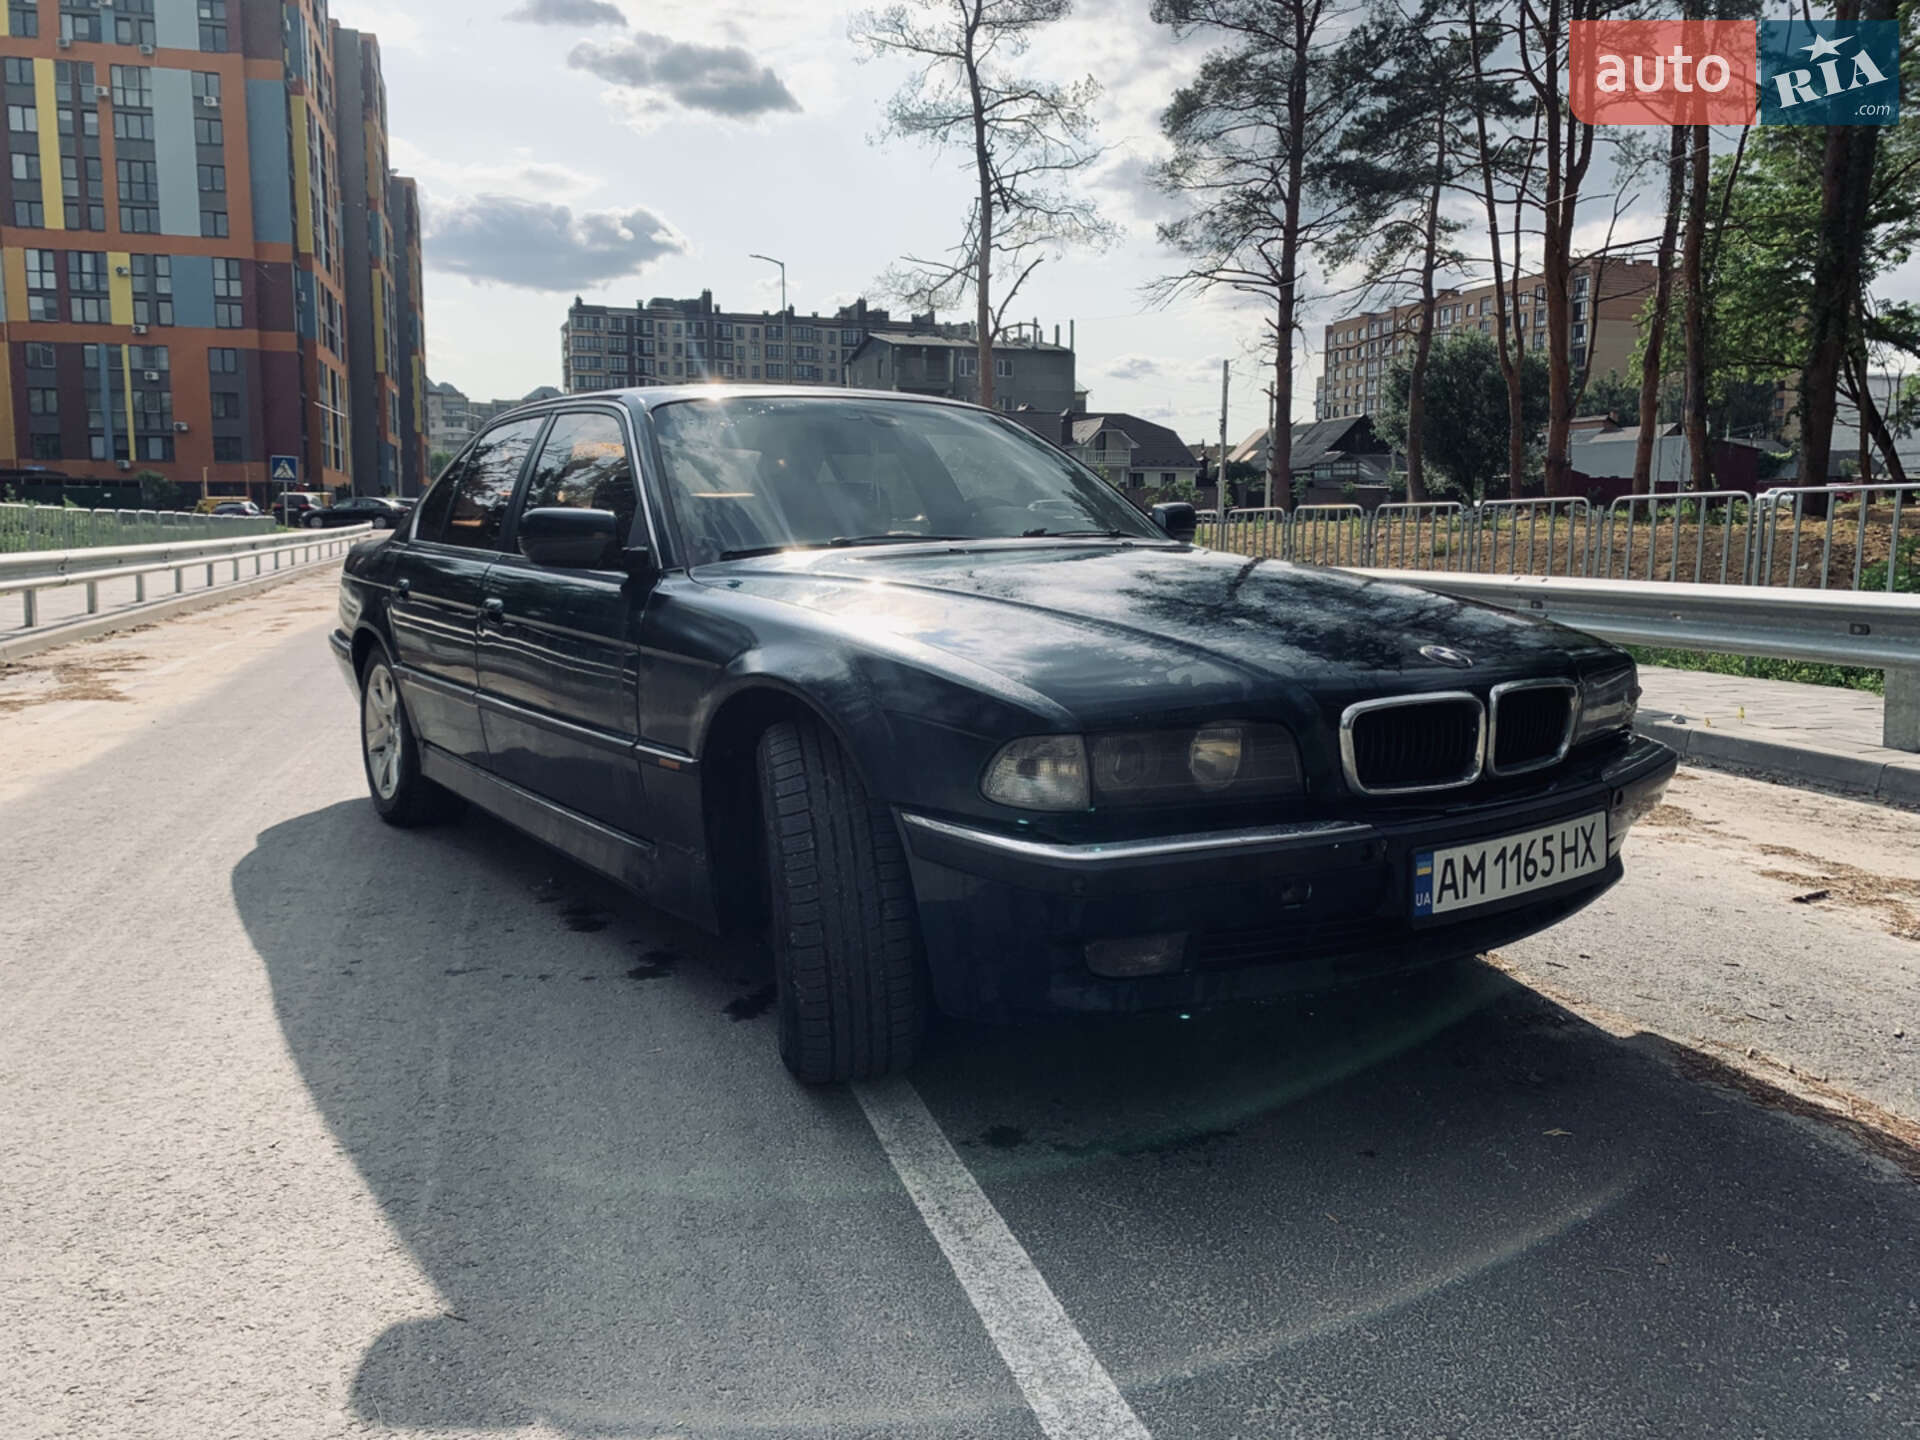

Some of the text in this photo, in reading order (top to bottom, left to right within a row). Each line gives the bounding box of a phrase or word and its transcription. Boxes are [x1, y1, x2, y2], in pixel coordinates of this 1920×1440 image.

[1437, 822, 1596, 904] AM 1165 HX
[1415, 893, 1431, 907] UA
